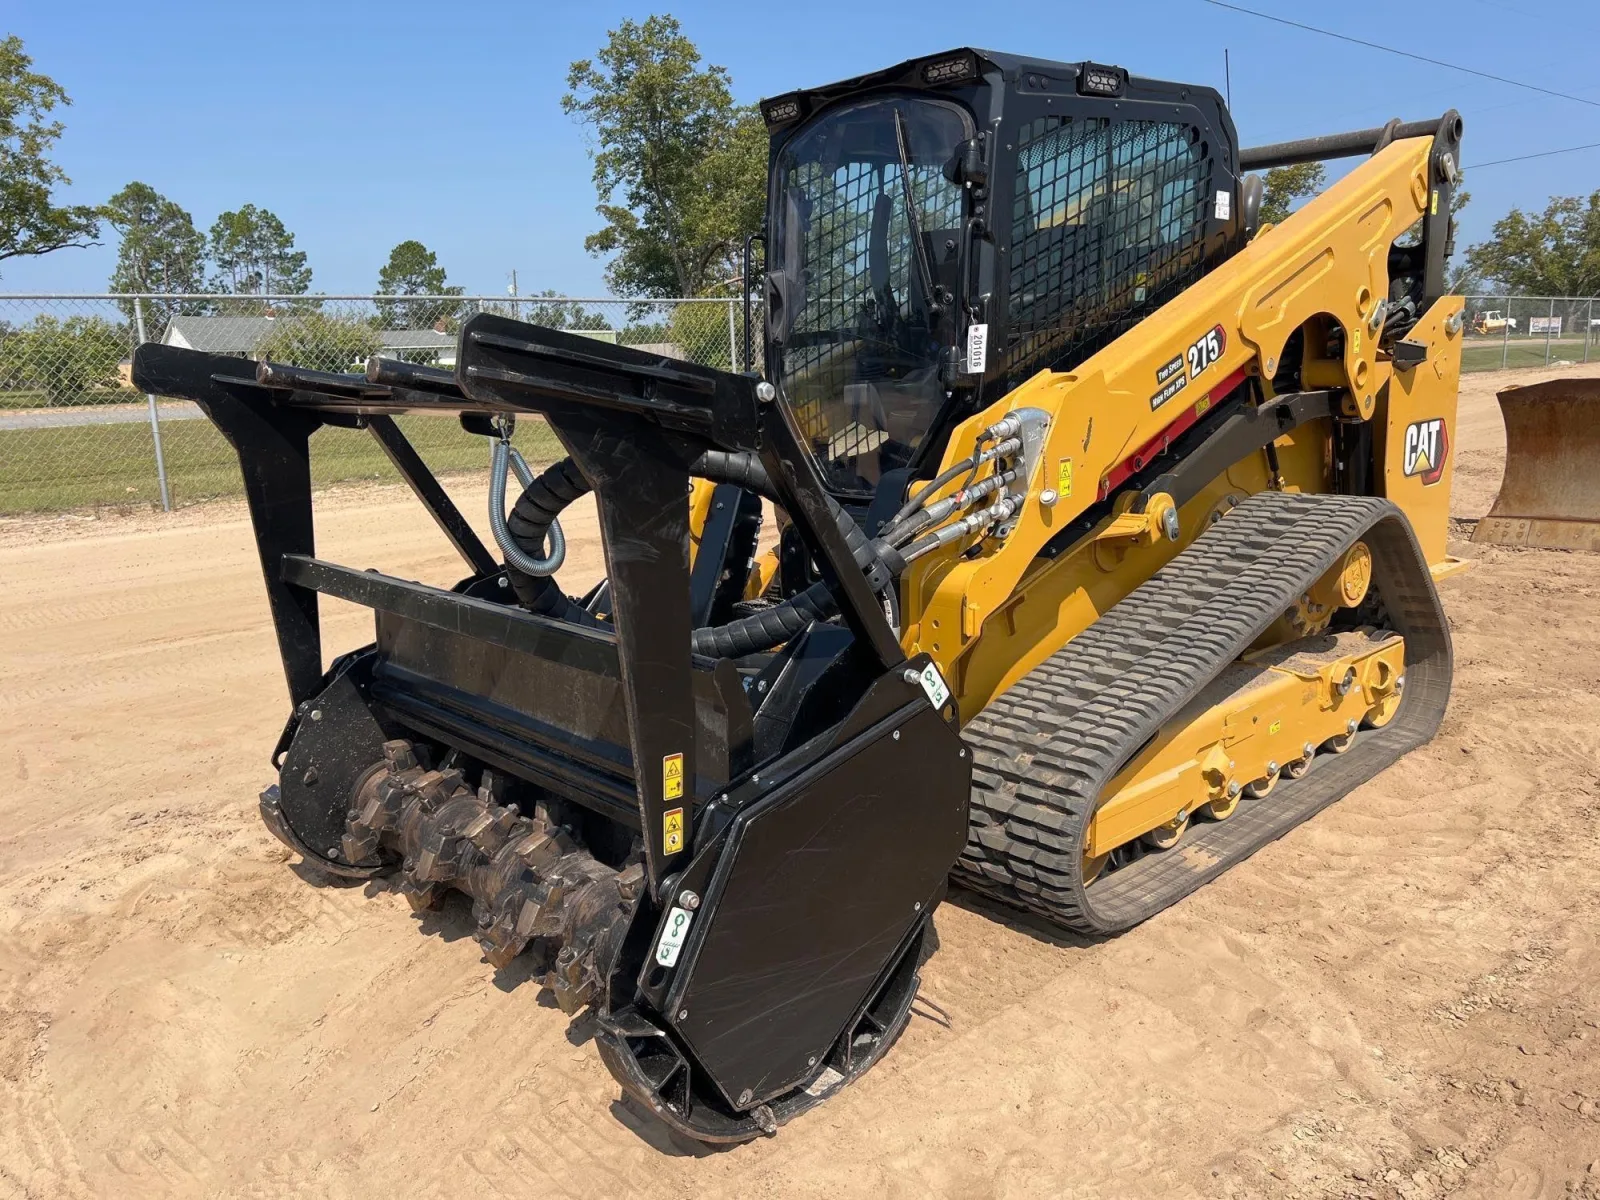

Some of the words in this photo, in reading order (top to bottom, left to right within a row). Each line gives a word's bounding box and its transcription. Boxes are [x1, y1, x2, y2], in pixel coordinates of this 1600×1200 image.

[973, 334, 983, 367] 201016
[1187, 329, 1219, 378] 275
[1404, 420, 1441, 475] CAT
